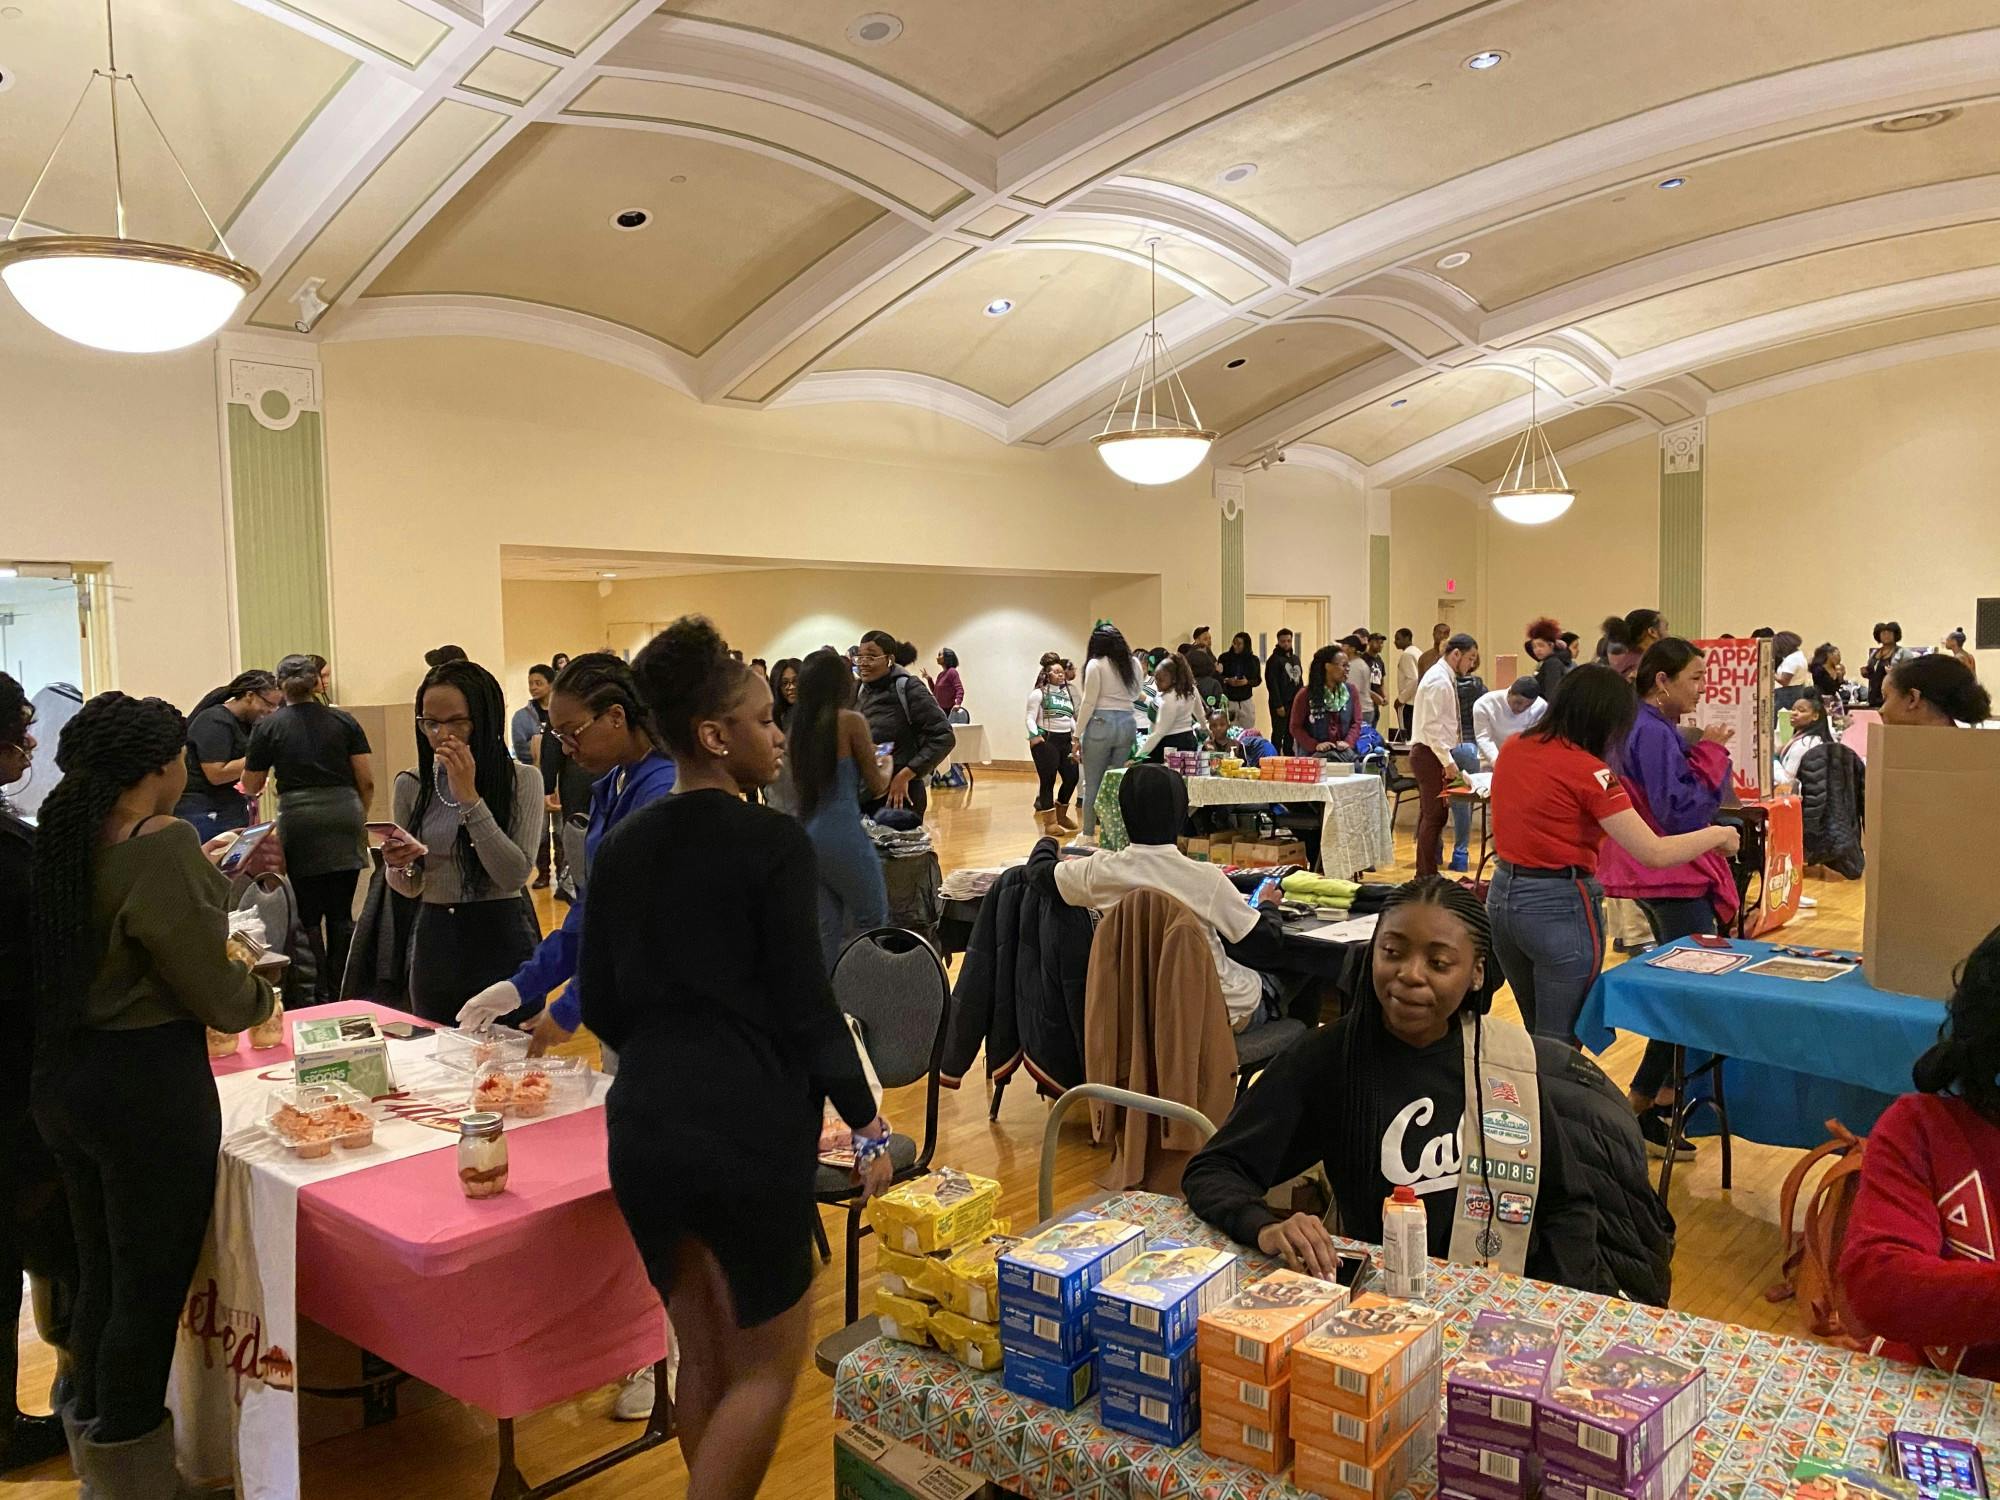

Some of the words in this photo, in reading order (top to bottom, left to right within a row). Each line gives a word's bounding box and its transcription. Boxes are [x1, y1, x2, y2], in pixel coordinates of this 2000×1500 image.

[1706, 648, 1757, 667] APPA
[1707, 668, 1760, 687] LPHA
[1705, 686, 1741, 705] PSI
[304, 1069, 346, 1083] SPOONS
